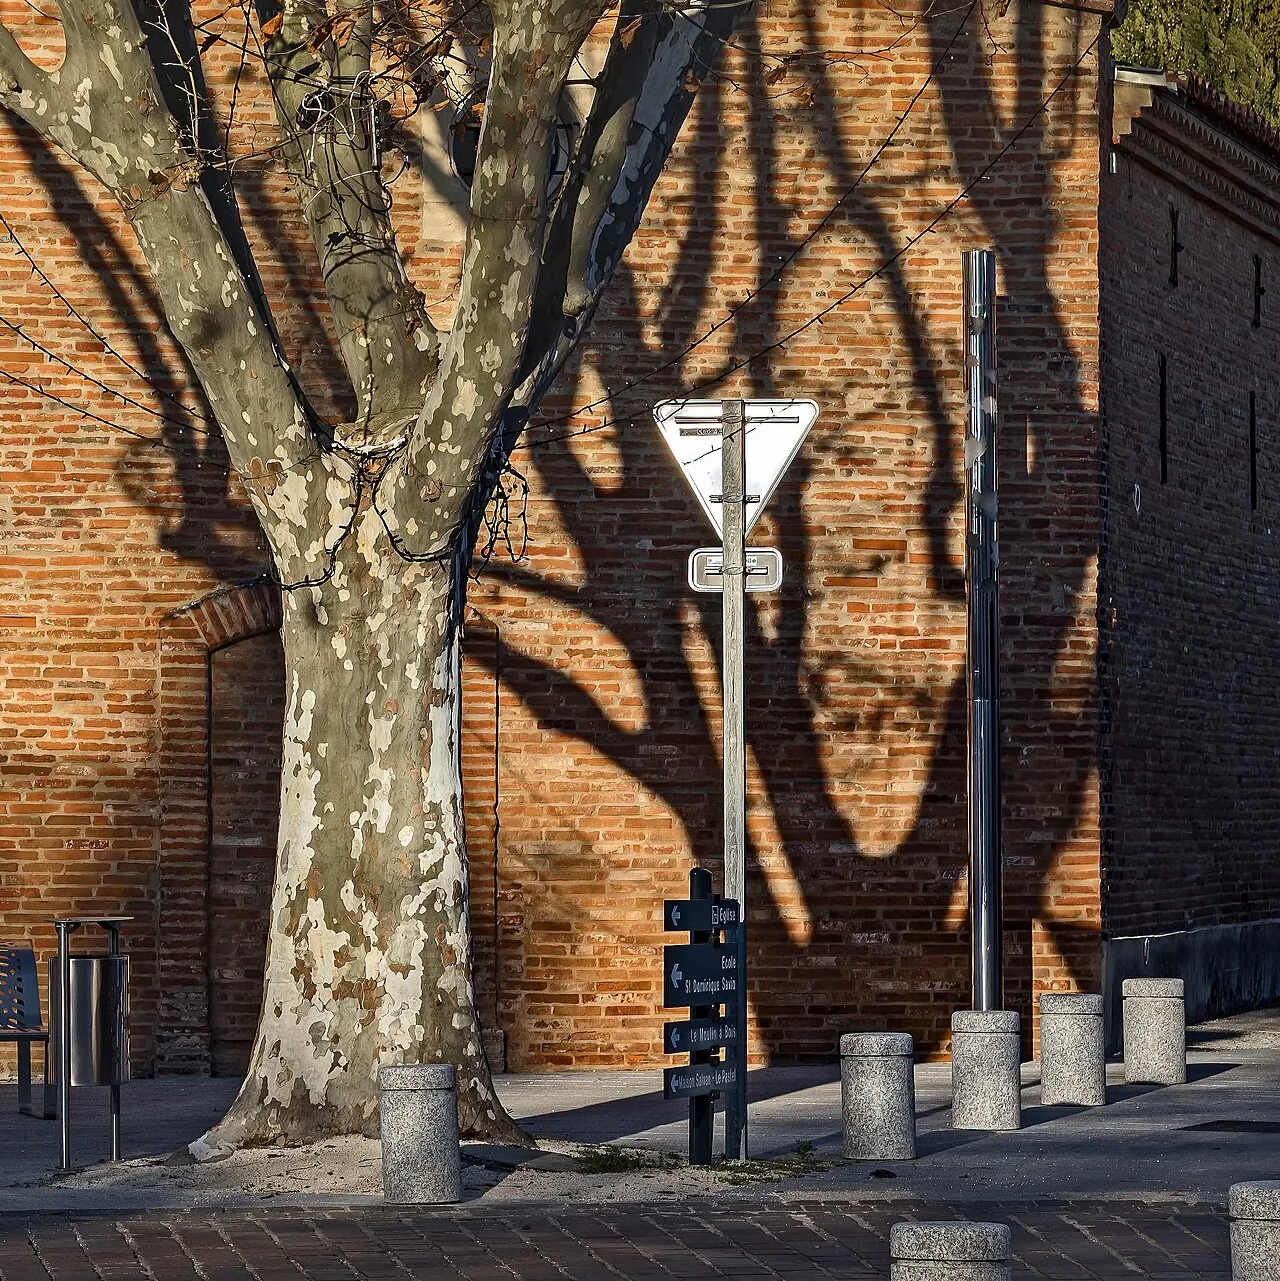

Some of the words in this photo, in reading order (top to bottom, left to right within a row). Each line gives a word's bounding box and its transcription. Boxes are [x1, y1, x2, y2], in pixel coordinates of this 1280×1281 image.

[719, 907, 736, 924] Eglise
[721, 955, 737, 970] Ecole
[684, 979, 691, 994] St
[692, 978, 720, 995] Dominique
[721, 976, 736, 991] Savio
[690, 1028, 697, 1043] Le
[699, 1026, 717, 1042] Moulin
[724, 1024, 736, 1039] Bois
[678, 1075, 695, 1090] Maison
[695, 1072, 711, 1087] Salvan
[715, 1070, 721, 1085] Le
[721, 1068, 737, 1084] Pastel
